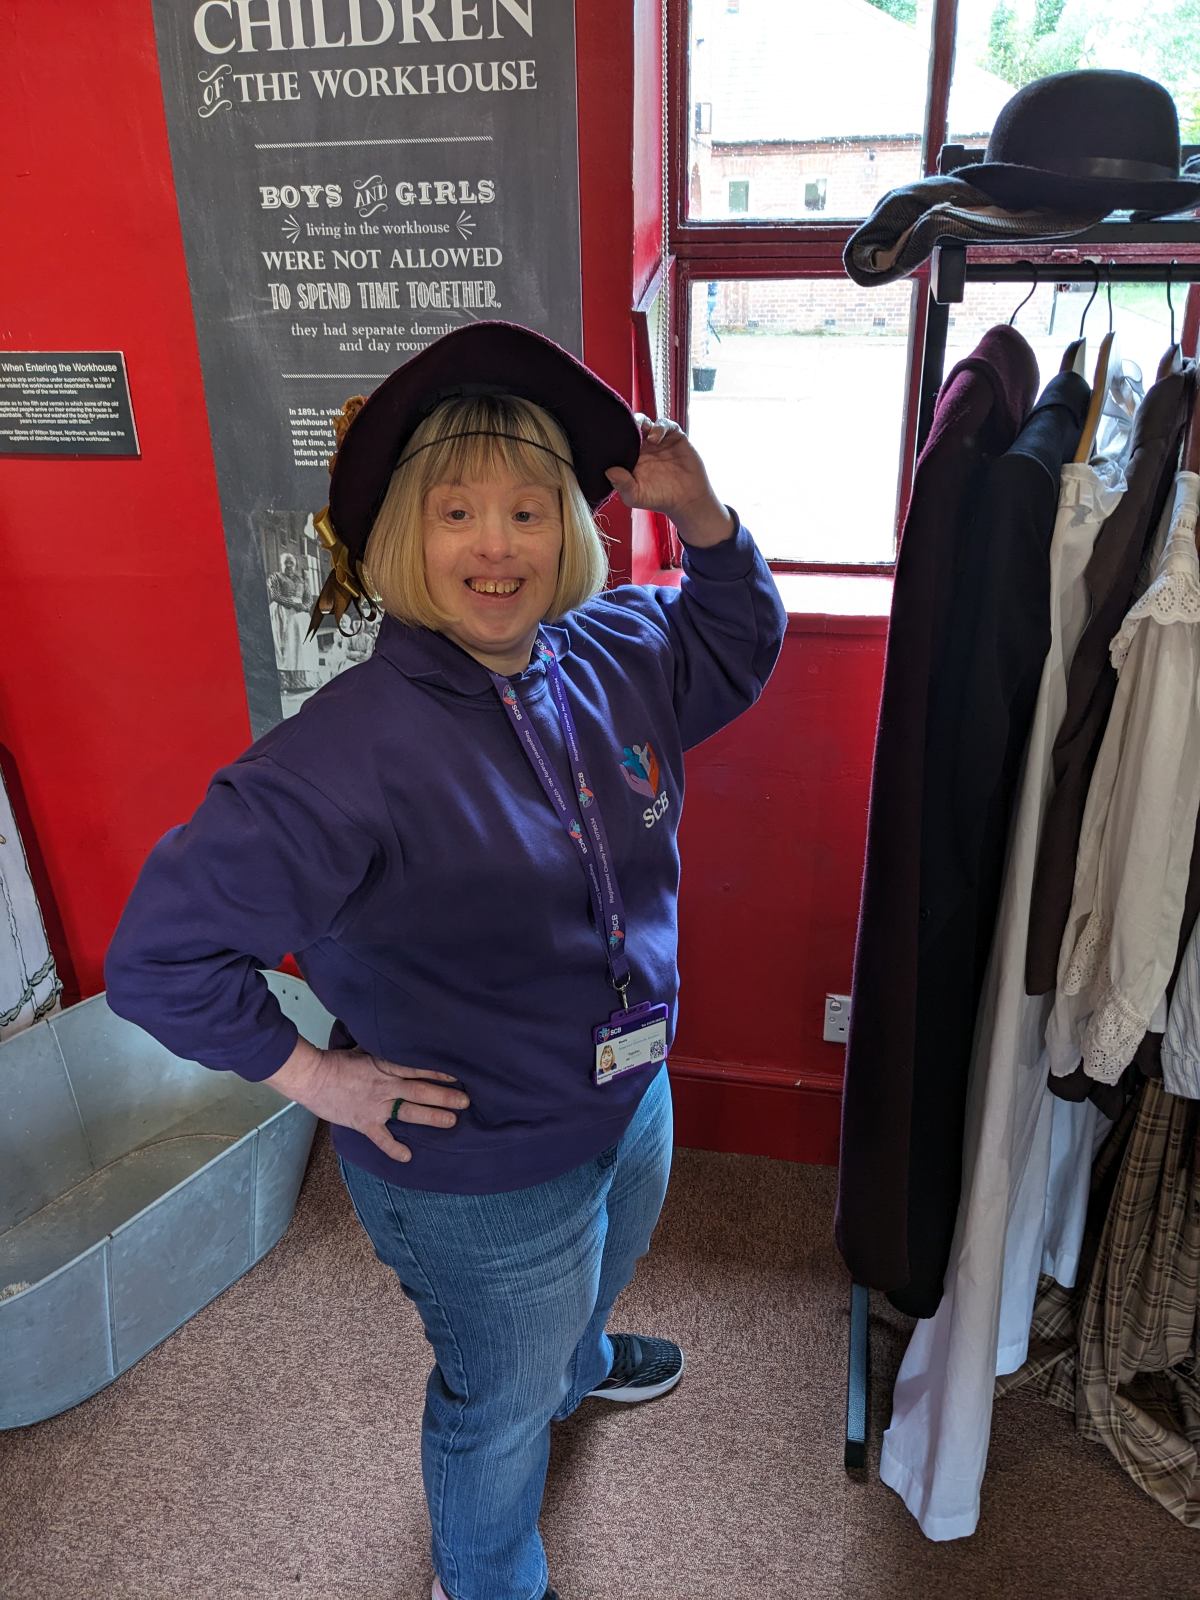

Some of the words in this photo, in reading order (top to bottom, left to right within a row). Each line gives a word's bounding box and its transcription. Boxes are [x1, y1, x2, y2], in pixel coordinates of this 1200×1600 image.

[194, 0, 534, 54] CHILDREN
[201, 70, 228, 111] OF
[233, 71, 301, 103] THE
[311, 60, 538, 100] WORKHOUSE
[259, 184, 343, 209] BOYS
[354, 180, 388, 212] AND
[395, 180, 496, 206] GIRLS
[306, 222, 341, 239] living
[344, 222, 356, 236] in
[359, 221, 380, 235] the
[382, 220, 450, 235] workhouse
[261, 250, 326, 271] WERE
[334, 249, 381, 270] NOT
[390, 247, 503, 269] ALLOWED
[268, 282, 291, 310] TO
[297, 282, 351, 310] SPEND
[357, 281, 400, 309] TIME
[406, 280, 502, 309] TOGETHER.
[291, 323, 318, 338] they
[323, 323, 347, 337] had
[352, 324, 406, 339] separate
[339, 339, 363, 352] and
[368, 338, 391, 353] day
[1, 363, 24, 372] When
[25, 363, 57, 374] Entering
[58, 363, 71, 372] the
[72, 363, 118, 372] Workhouse
[298, 408, 319, 416] 1891,
[326, 408, 345, 416] visito
[310, 429, 332, 437] caring
[308, 439, 326, 447] time,
[535, 638, 547, 651] SCB
[511, 704, 522, 721] SCB
[524, 729, 541, 759] Registered
[538, 758, 550, 778] Charity
[577, 772, 587, 789] SCB
[643, 790, 670, 829] SCB
[578, 838, 588, 854] SCB
[611, 914, 619, 931] SCB
